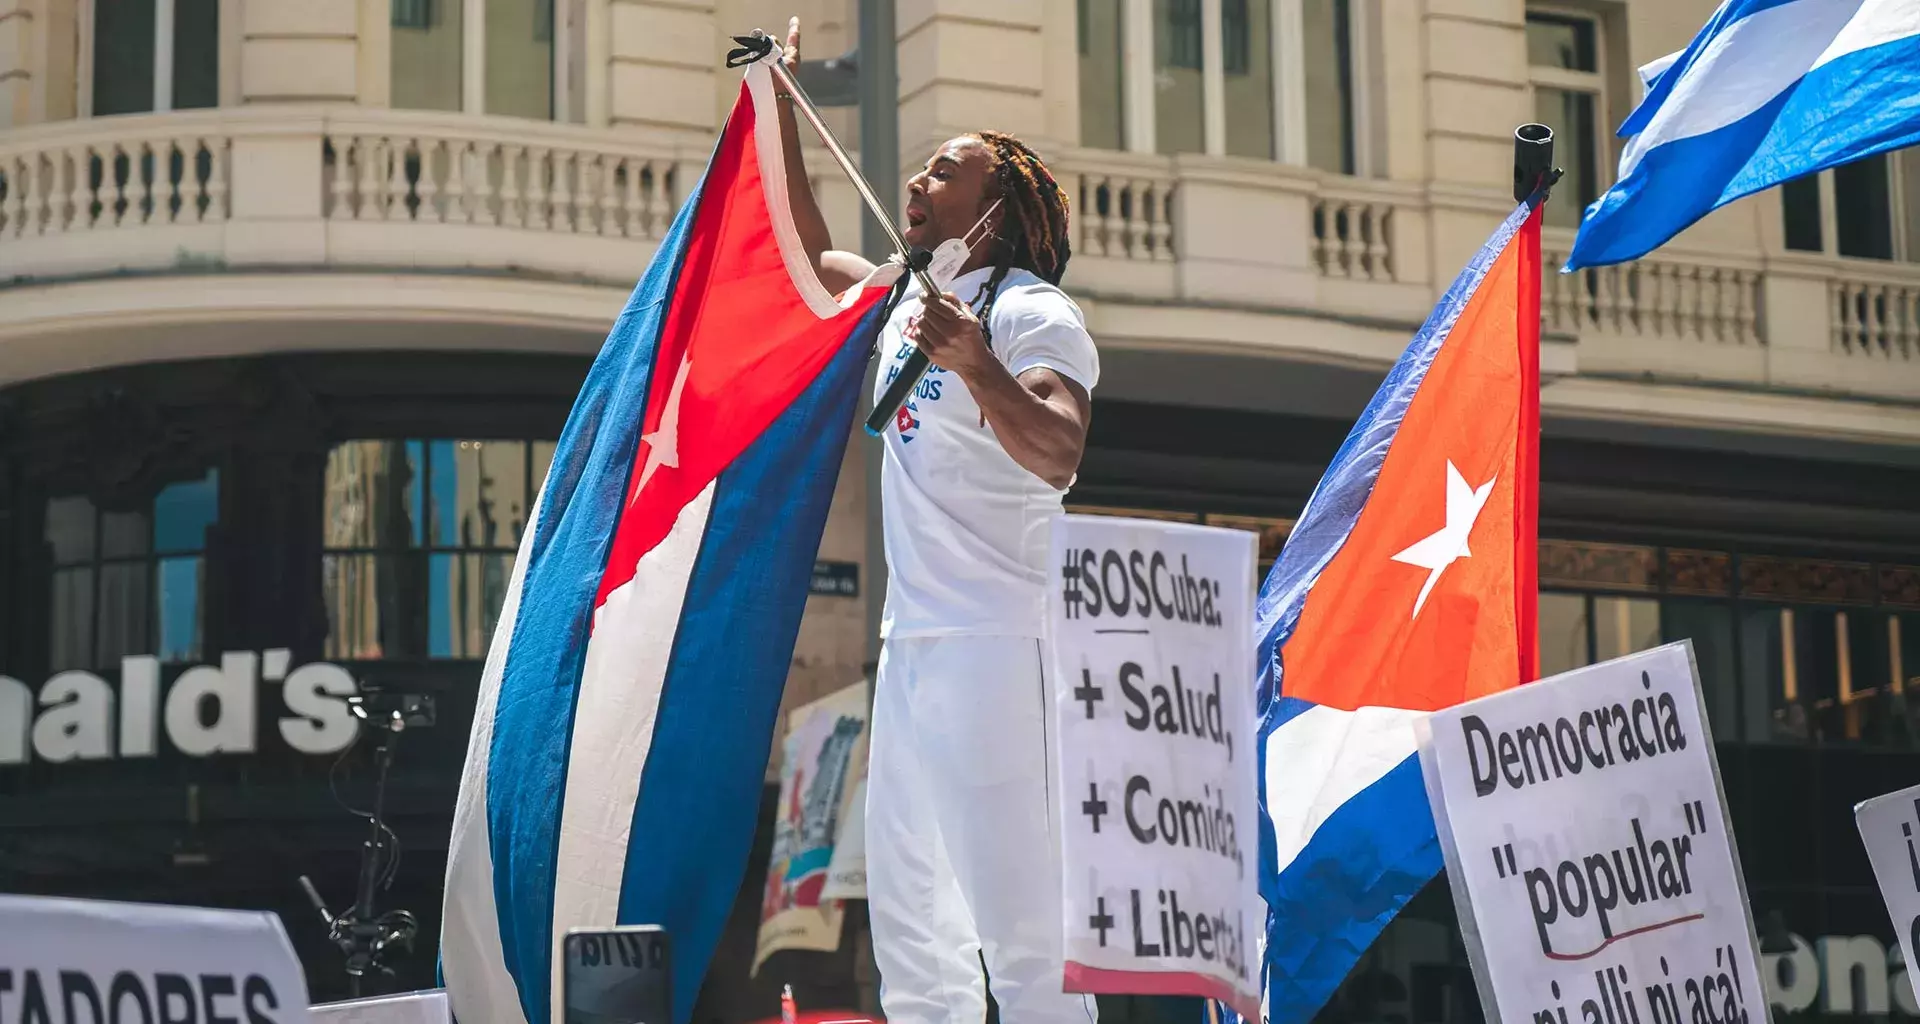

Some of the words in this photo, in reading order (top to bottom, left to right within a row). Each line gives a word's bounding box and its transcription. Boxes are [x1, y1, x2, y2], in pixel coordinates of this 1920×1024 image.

[1062, 548, 1222, 628] #SOSCuba:
[1074, 668, 1104, 720] +
[1118, 661, 1233, 763] Salud,
[1460, 670, 1687, 798] Democracia
[1081, 782, 1108, 833] +
[1124, 775, 1244, 880] Comida,
[1492, 800, 1707, 954] "popular"
[1089, 897, 1115, 947] +
